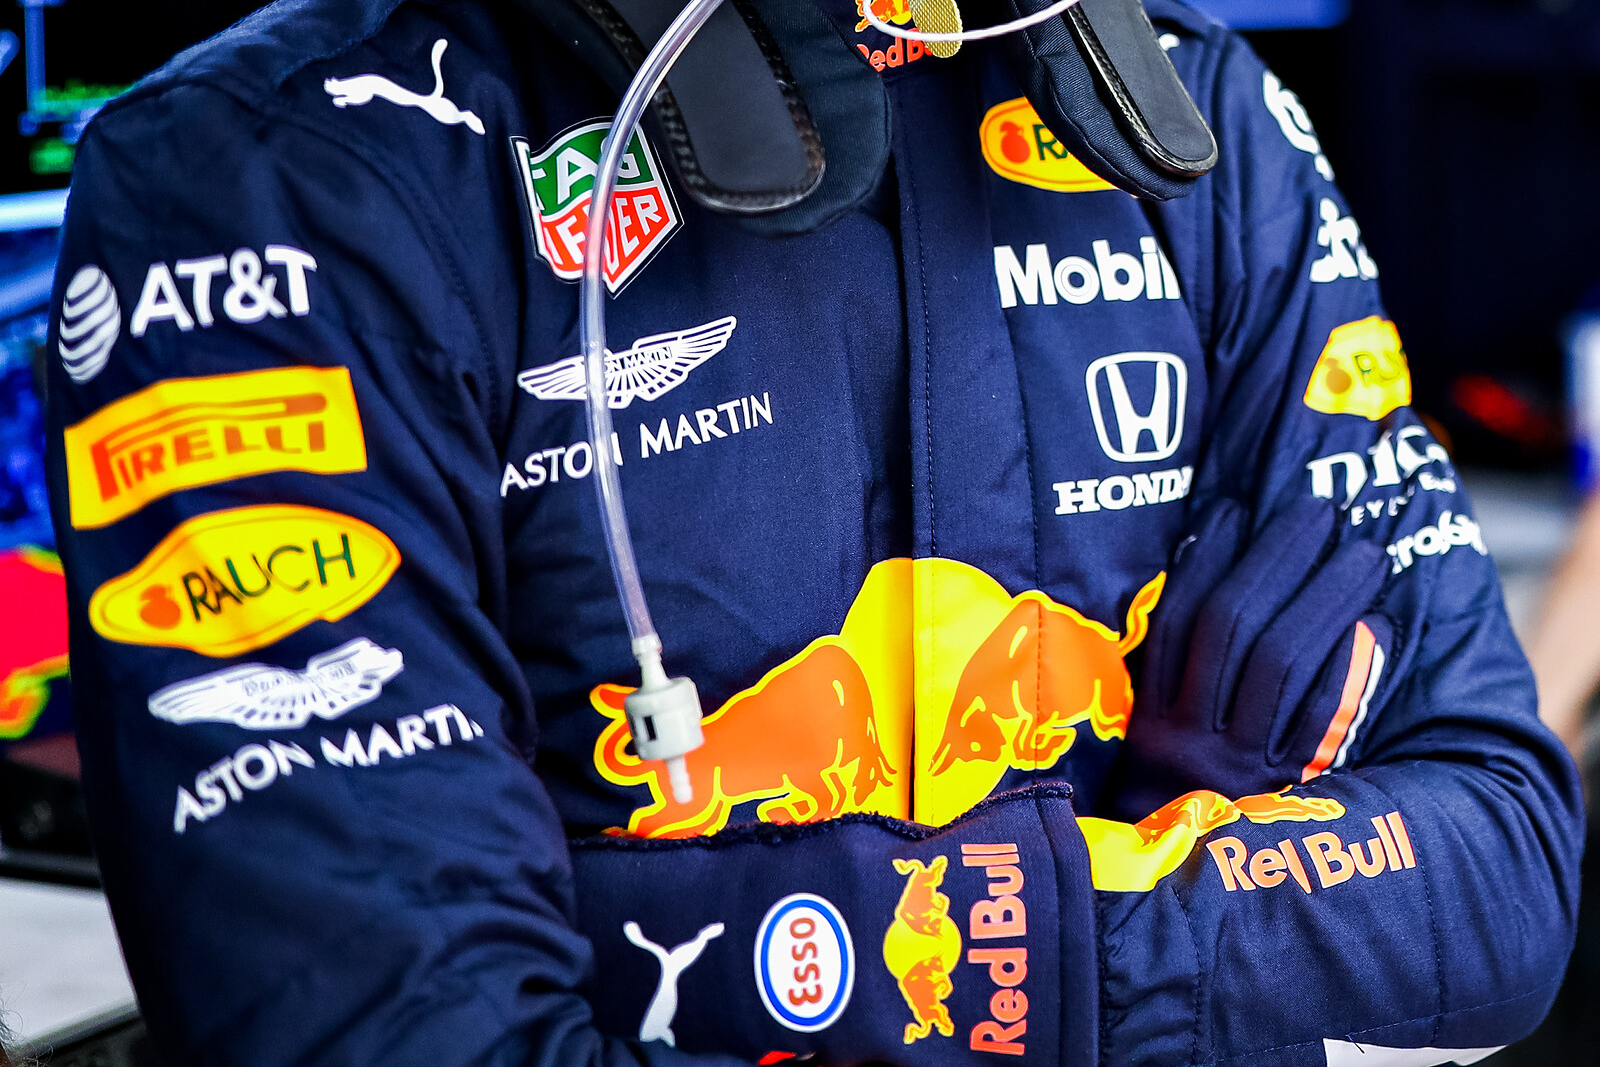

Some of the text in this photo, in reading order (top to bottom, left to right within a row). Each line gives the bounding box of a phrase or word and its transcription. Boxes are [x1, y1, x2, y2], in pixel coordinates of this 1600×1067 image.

[130, 244, 318, 338] AT&T
[993, 235, 1181, 309] Mobil
[89, 392, 328, 503] PIRELLI
[639, 391, 774, 459] MARTIN
[182, 532, 356, 623] RAUCH
[173, 738, 316, 834] ASTON
[1302, 811, 1417, 890] Bull
[960, 842, 1029, 1056] Red Bull
